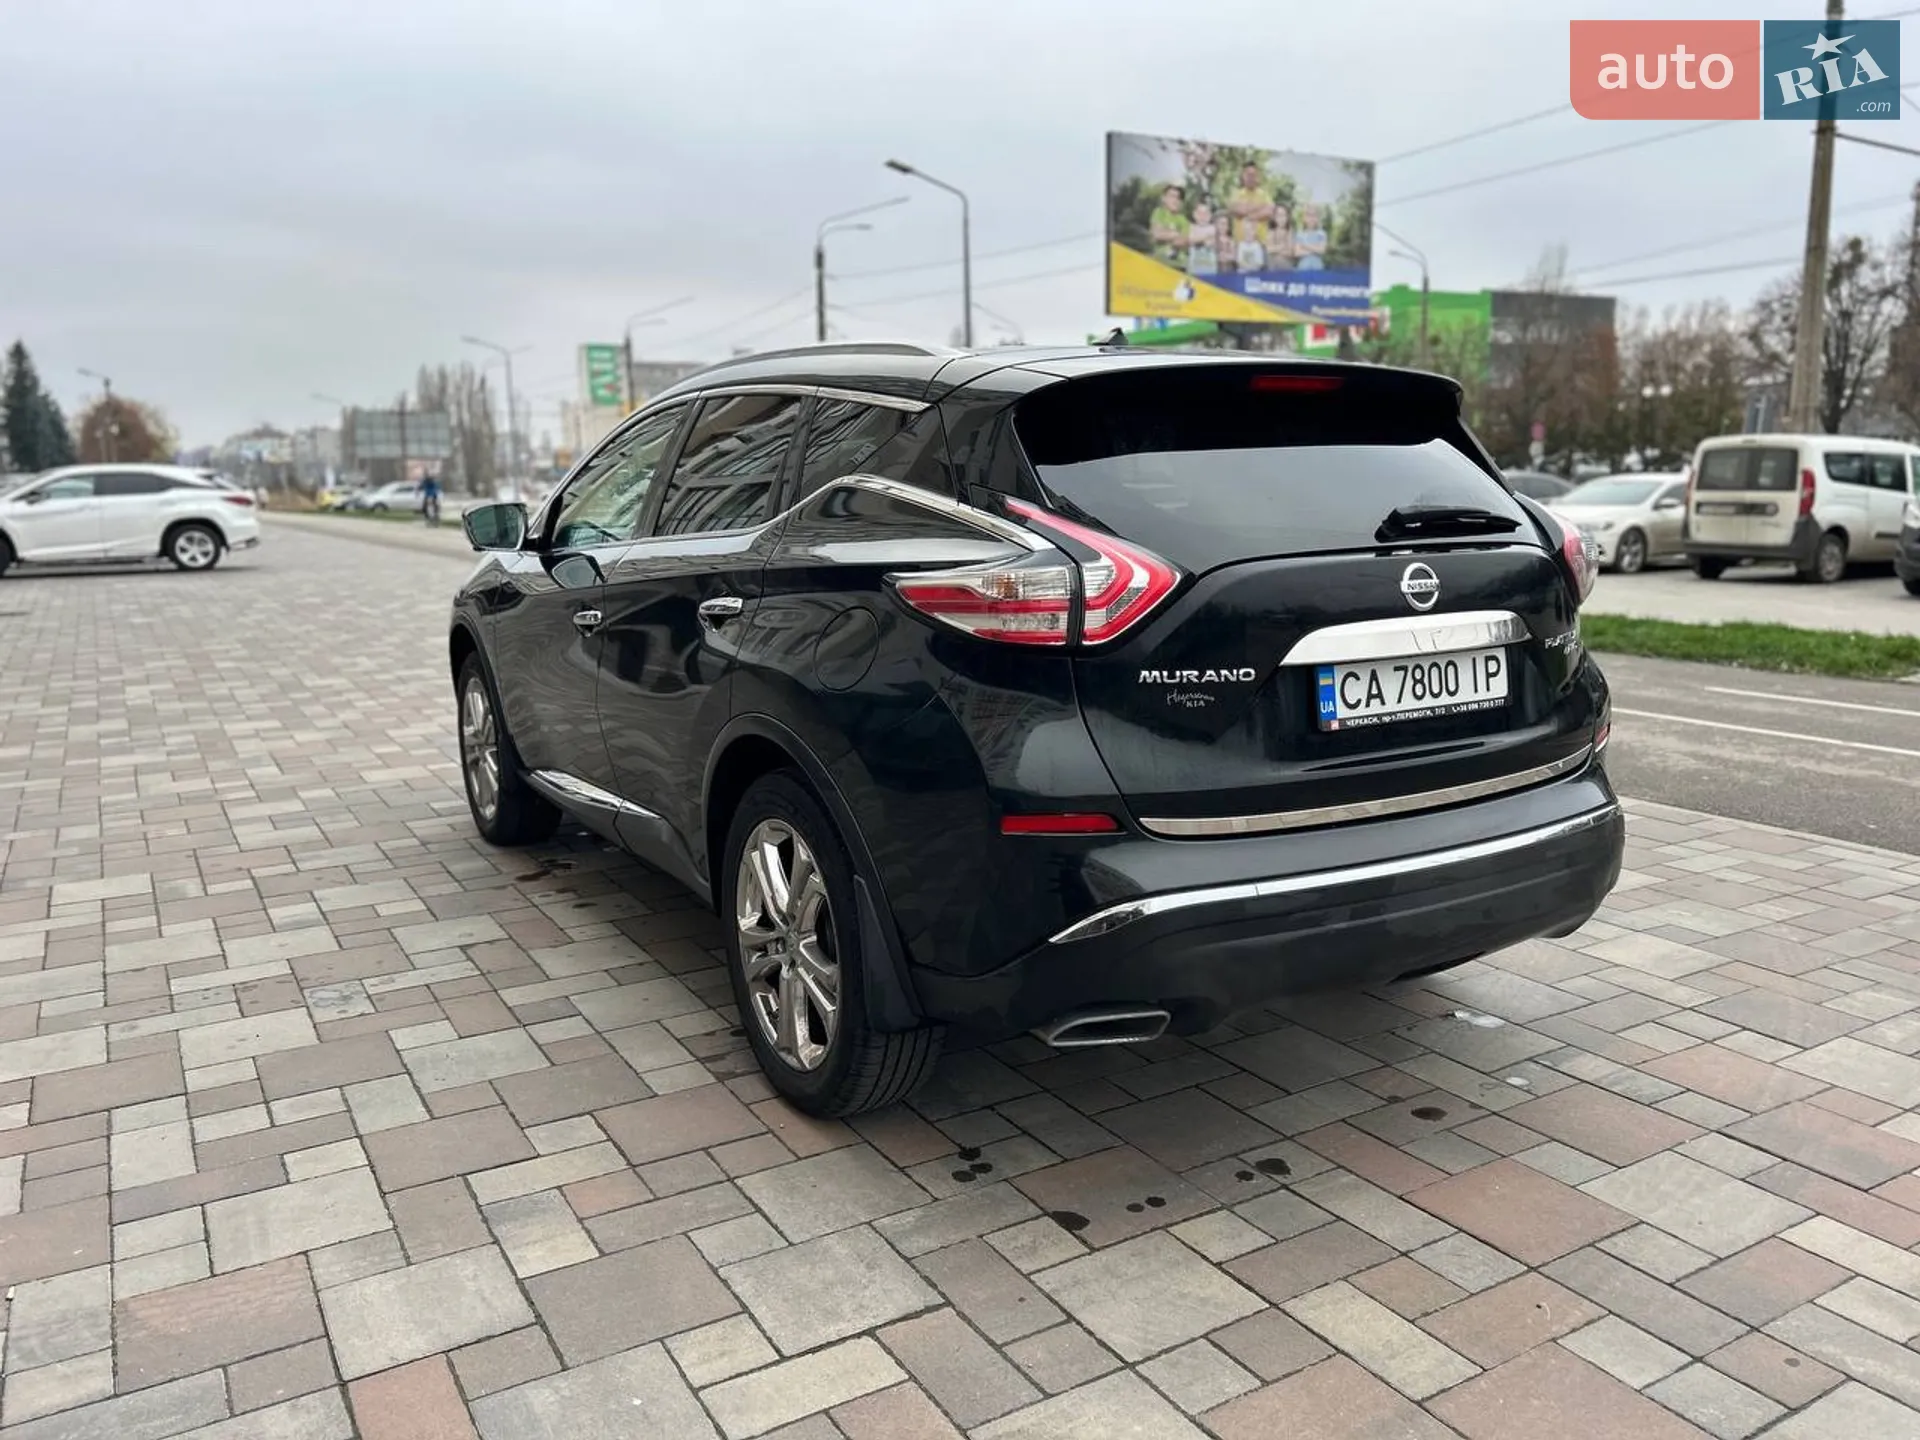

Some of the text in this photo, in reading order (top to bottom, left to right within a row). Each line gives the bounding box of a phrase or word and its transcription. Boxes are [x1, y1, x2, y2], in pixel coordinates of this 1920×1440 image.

[1287, 282, 1307, 298] до
[1406, 580, 1439, 591] NISSAN
[1138, 667, 1257, 684] MURANO
[1339, 654, 1502, 710] CA 7800 IP
[1320, 701, 1335, 714] UA
